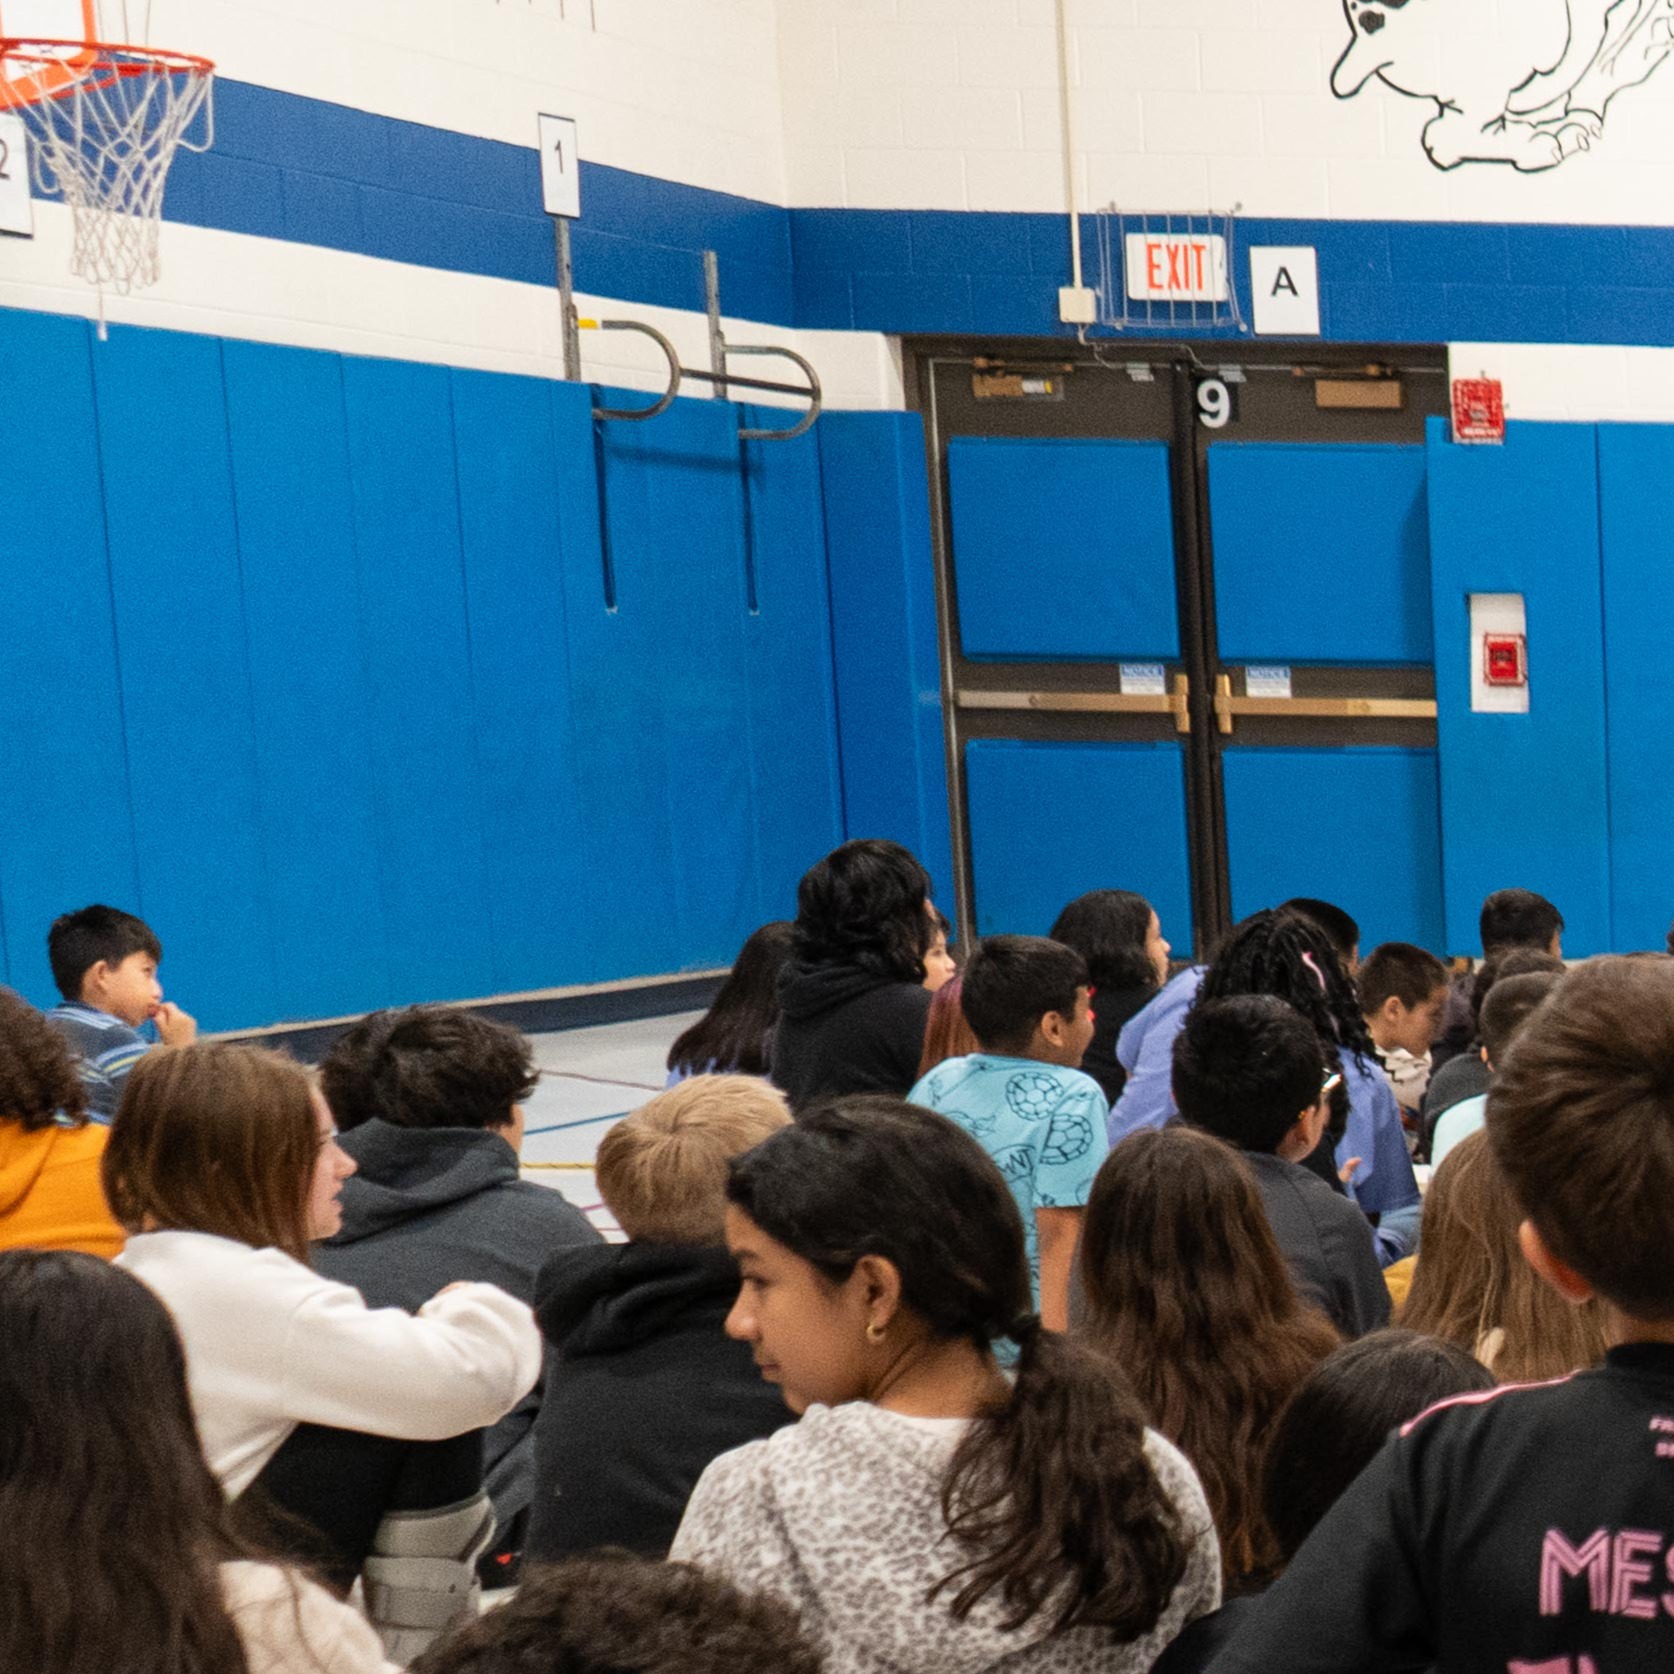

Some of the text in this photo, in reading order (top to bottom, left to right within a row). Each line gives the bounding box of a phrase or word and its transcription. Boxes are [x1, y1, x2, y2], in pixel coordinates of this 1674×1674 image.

[553, 140, 565, 175] 1
[1146, 243, 1207, 291] EXIT
[1270, 266, 1299, 297] A
[1196, 379, 1231, 428] 9
